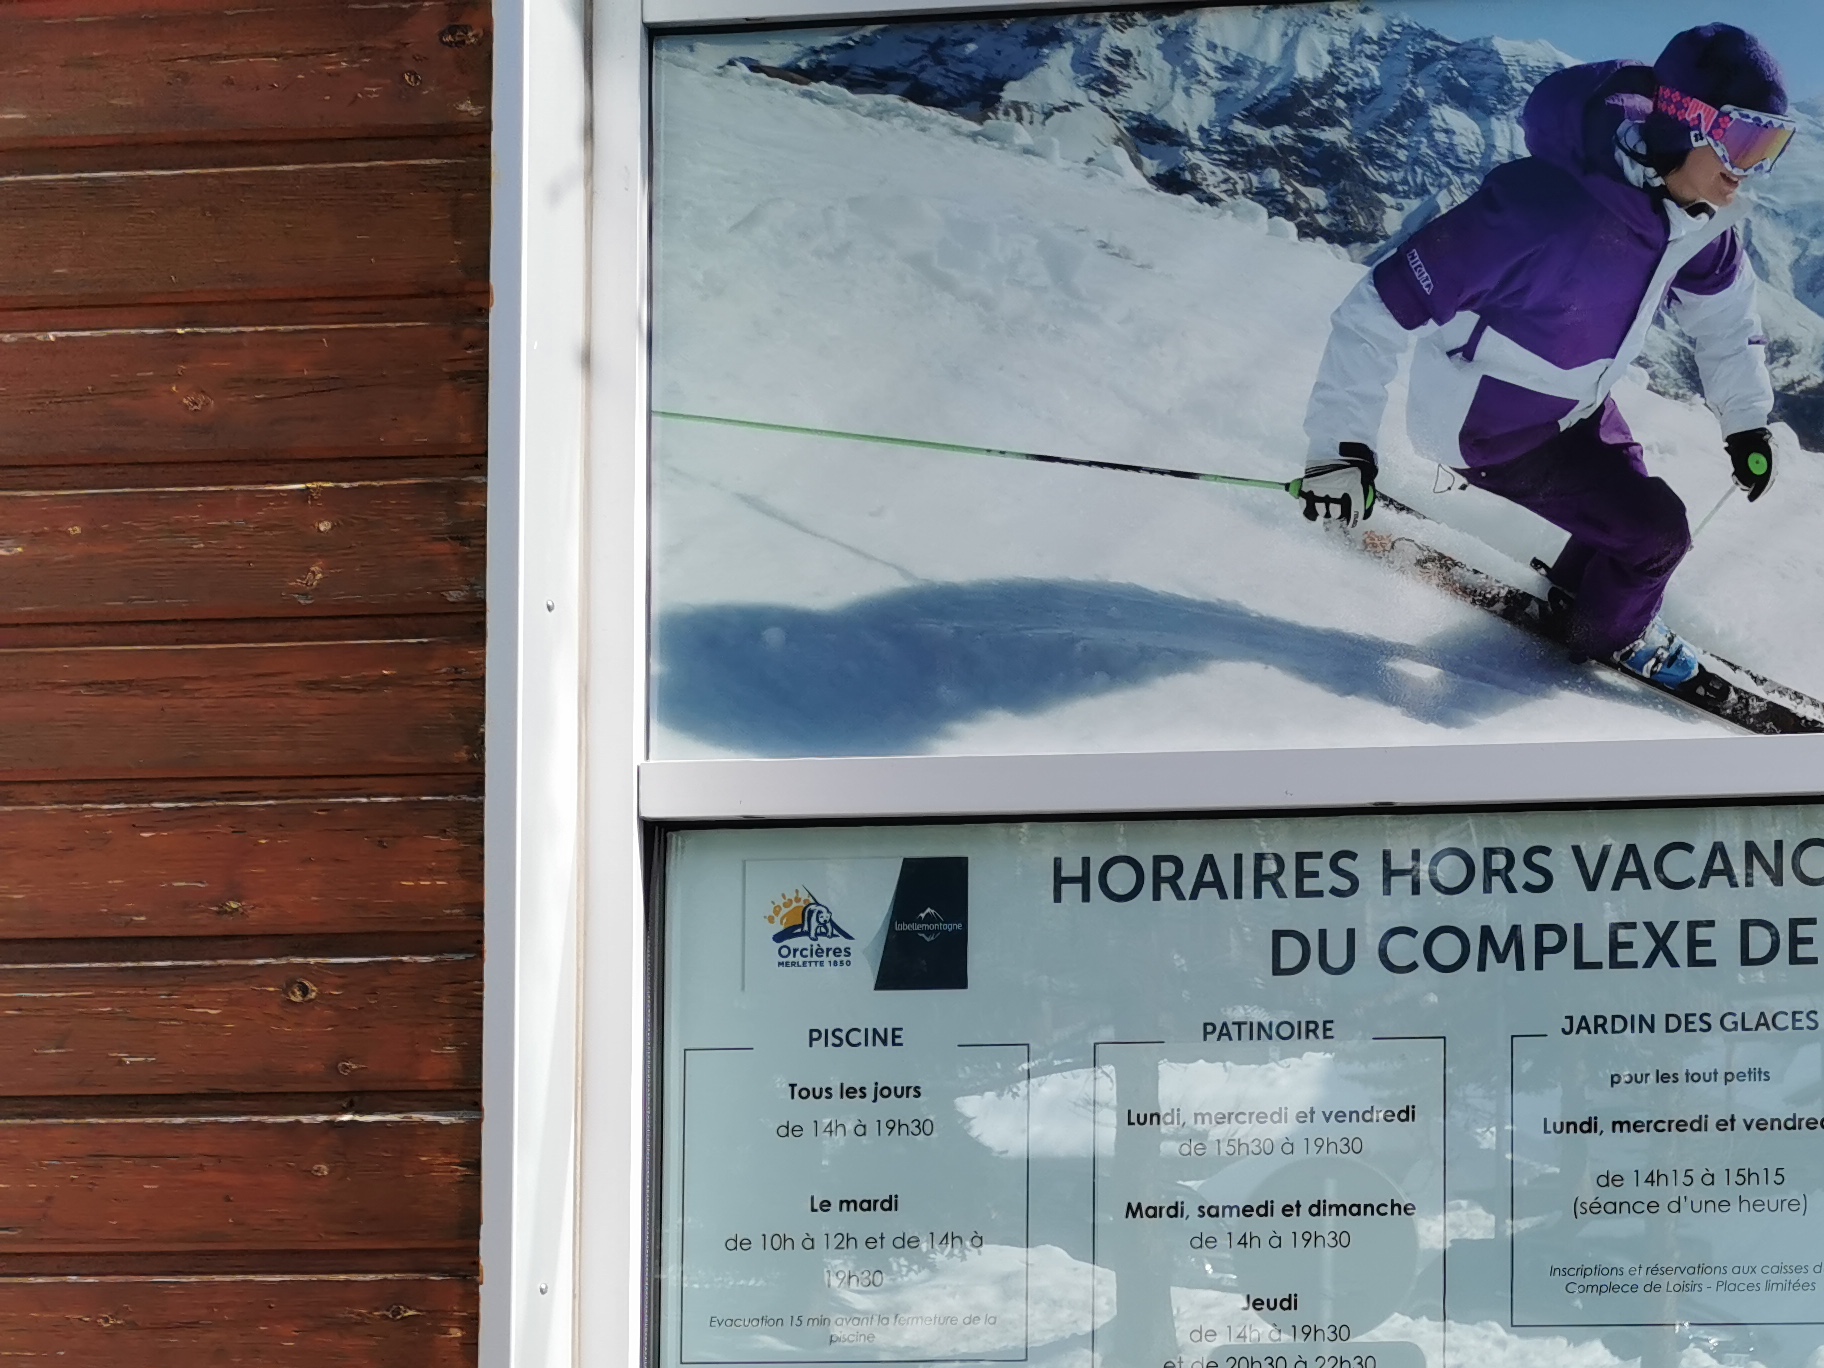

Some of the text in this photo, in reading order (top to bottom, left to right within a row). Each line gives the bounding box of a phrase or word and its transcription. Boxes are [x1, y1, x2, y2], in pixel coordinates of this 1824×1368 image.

[1406, 248, 1434, 295] NIKITA
[1053, 850, 1360, 903] HORAIRES
[1383, 843, 1553, 896] HORS
[895, 921, 963, 932] labellemontagne
[777, 944, 852, 959] Orcières
[1271, 928, 1355, 976] DU
[1378, 920, 1716, 975] COMPLEXE
[1740, 917, 1818, 967] DE
[777, 959, 851, 968] MERLETTE 1850
[1203, 1020, 1335, 1041] PATINOIRE
[1561, 1010, 1819, 1036] JARDIN DES GLACES
[808, 1027, 904, 1048] PISCINE
[1610, 1067, 1771, 1088] pour les tout petits
[789, 1082, 921, 1103] Tous les jours
[1127, 1105, 1416, 1127] Lundi, mercredi et vendredi
[1543, 1116, 1604, 1136] Lundi,
[1611, 1114, 1708, 1133] mercredi
[1715, 1114, 1736, 1132] et
[776, 1118, 934, 1138] de 14h à 19h30
[1596, 1167, 1785, 1188] de 14h15 à 15h15
[810, 1194, 899, 1213] Le mardi
[1125, 1199, 1417, 1221] Mardi, samedi et dimanche
[1573, 1194, 1807, 1219] (séance d'une heure)
[725, 1230, 983, 1251] de 10h à 12h et de 14h à
[1190, 1230, 1350, 1249] de 14h à 19h30
[825, 1270, 884, 1288] 19h30
[1549, 1264, 1624, 1279] Inscriptions
[1628, 1264, 1643, 1277] et
[1646, 1262, 1728, 1277] réservations
[1732, 1265, 1757, 1275] aux
[1760, 1262, 1809, 1275] caisses
[1565, 1278, 1816, 1296] Complece de Loisirs Places limitées
[1241, 1293, 1299, 1311] Jeudi
